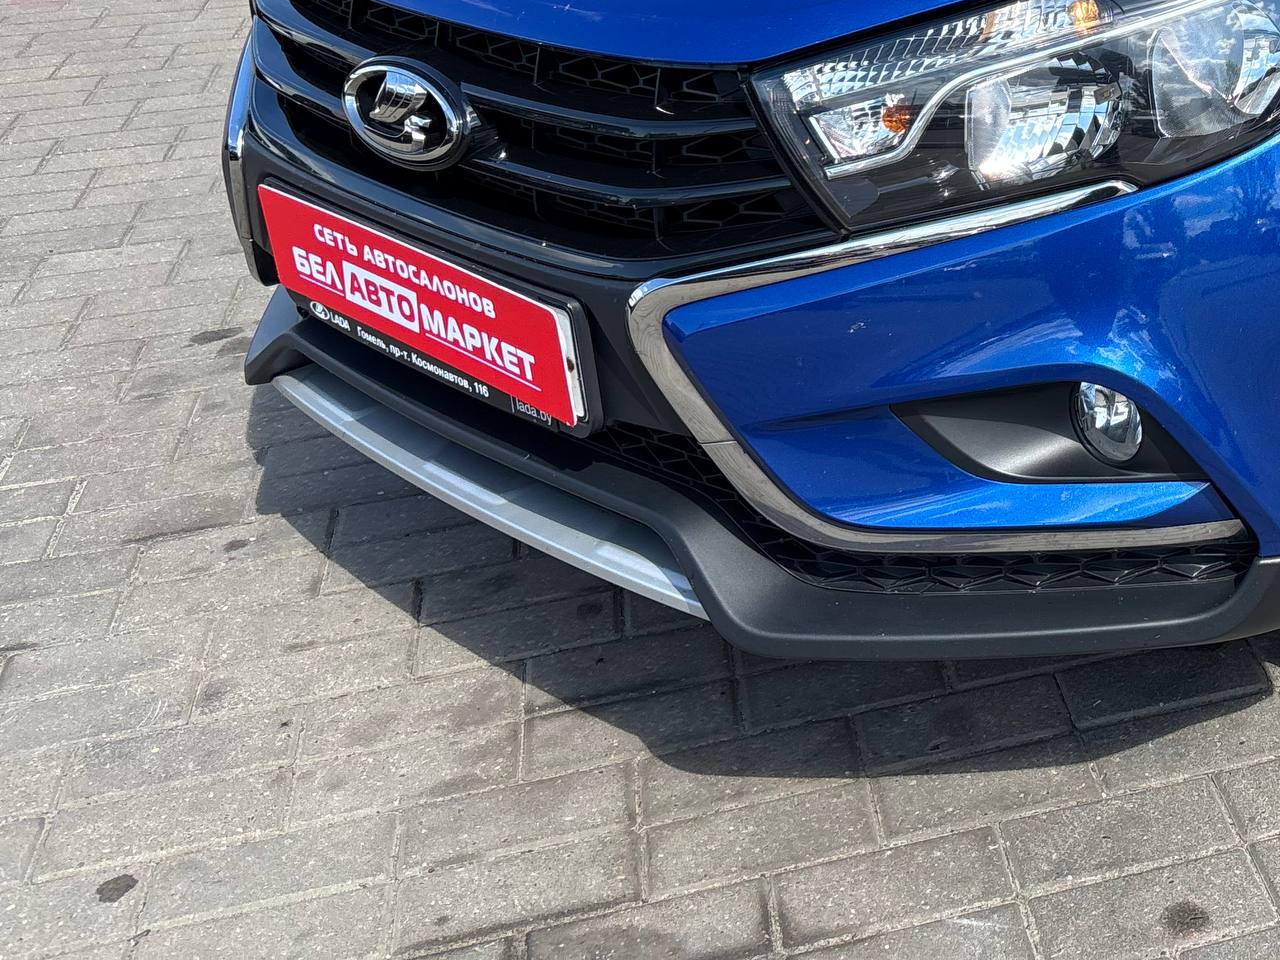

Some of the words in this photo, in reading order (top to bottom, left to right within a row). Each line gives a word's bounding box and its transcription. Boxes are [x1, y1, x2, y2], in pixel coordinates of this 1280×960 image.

[313, 223, 358, 257] СЕТЬ
[363, 244, 496, 319] АВТОСАЛОНОВ
[291, 245, 343, 291] БЕЛ
[350, 271, 415, 323] АВТО
[420, 303, 536, 382] МАРКЕТ
[330, 312, 350, 331] LADA
[357, 326, 389, 353] Гомель,
[389, 344, 411, 362] пр-т.
[411, 352, 472, 393] Космонавтов,
[474, 382, 489, 398] 116
